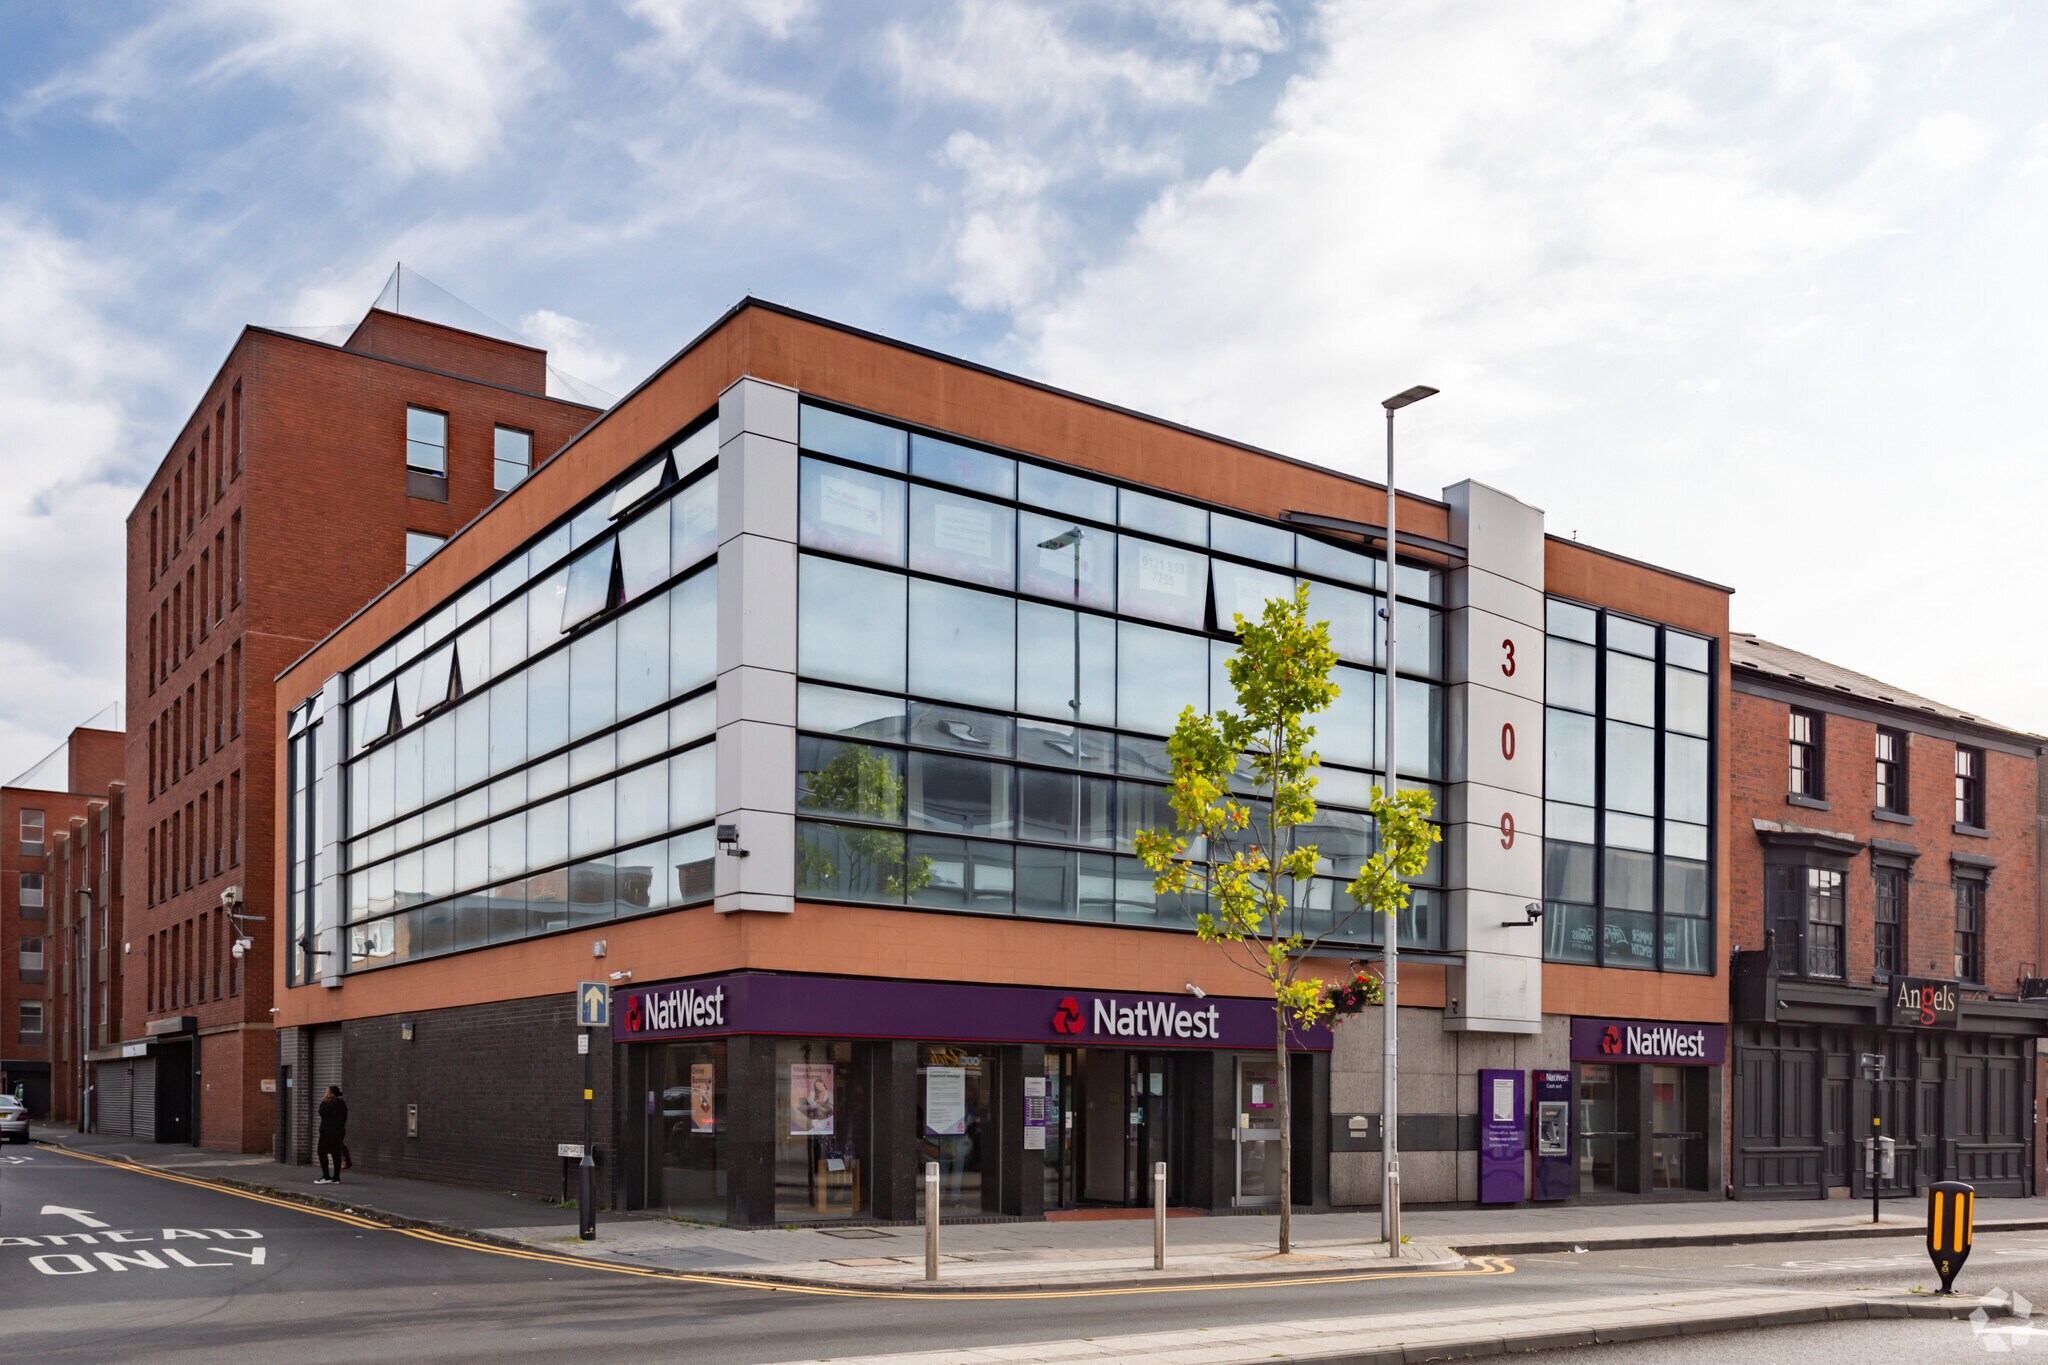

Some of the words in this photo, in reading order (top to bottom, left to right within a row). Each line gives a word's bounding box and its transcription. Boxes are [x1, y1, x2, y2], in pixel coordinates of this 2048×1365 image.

[1142, 556, 1164, 570] 0121
[1168, 560, 1185, 575] 553
[1152, 571, 1175, 586] 7755
[645, 985, 724, 1031] NatWest
[1896, 981, 1955, 1025] Angels
[1093, 998, 1220, 1039] NatWest
[1626, 1026, 1705, 1058] NatWest
[1546, 1072, 1569, 1082] NatWest
[0, 1227, 264, 1247] AHEAD
[29, 1246, 266, 1276] ONLY
